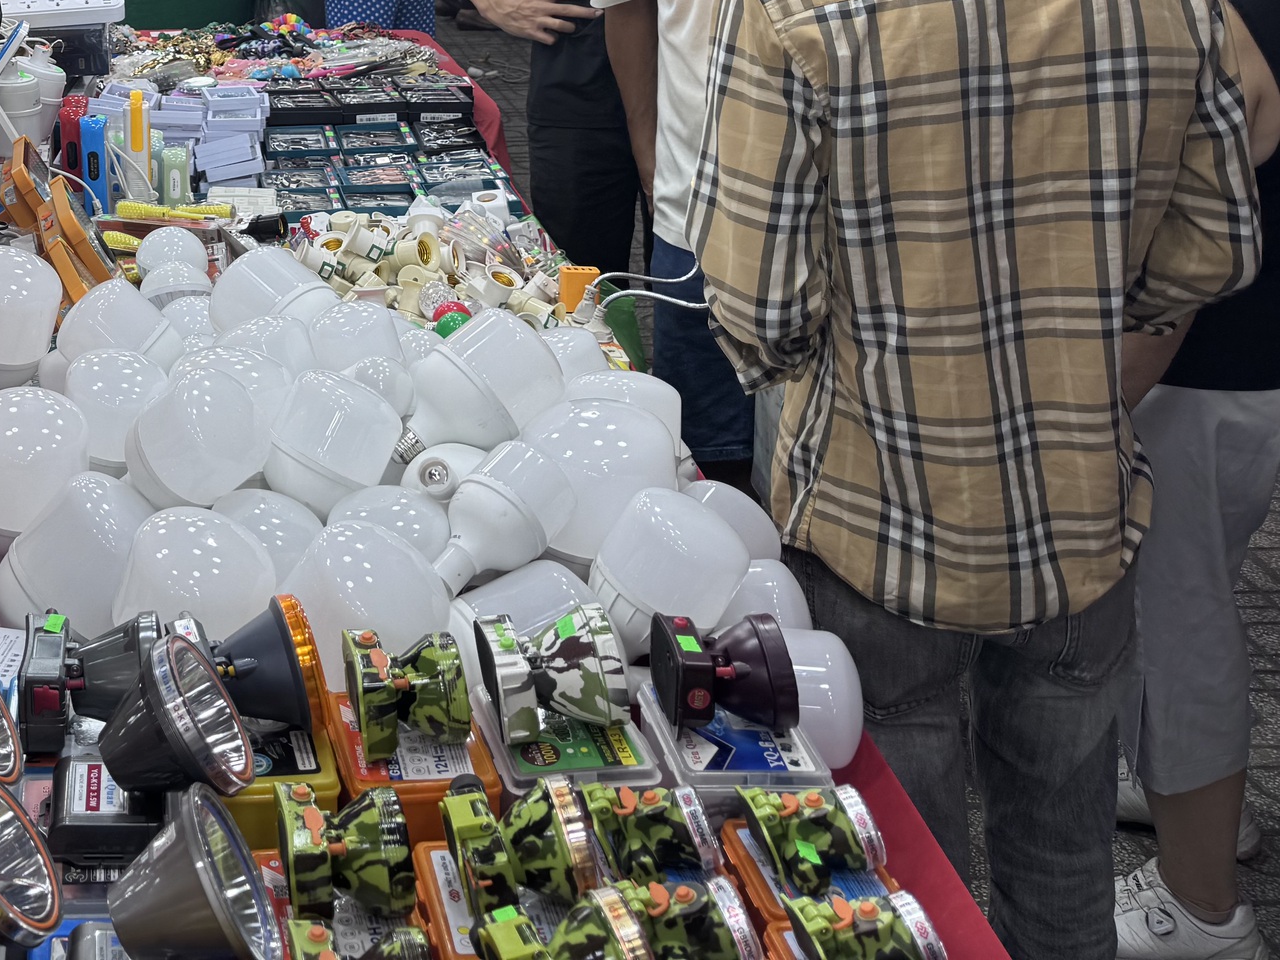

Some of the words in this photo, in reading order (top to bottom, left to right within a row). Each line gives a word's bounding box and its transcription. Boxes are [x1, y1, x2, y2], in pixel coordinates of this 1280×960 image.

[538, 742, 558, 763] 100W
[610, 732, 633, 760] LR-43
[433, 753, 449, 775] 12H
[91, 768, 99, 790] YQ-K19
[89, 790, 97, 808] 3.5W
[105, 783, 117, 807] Quan
